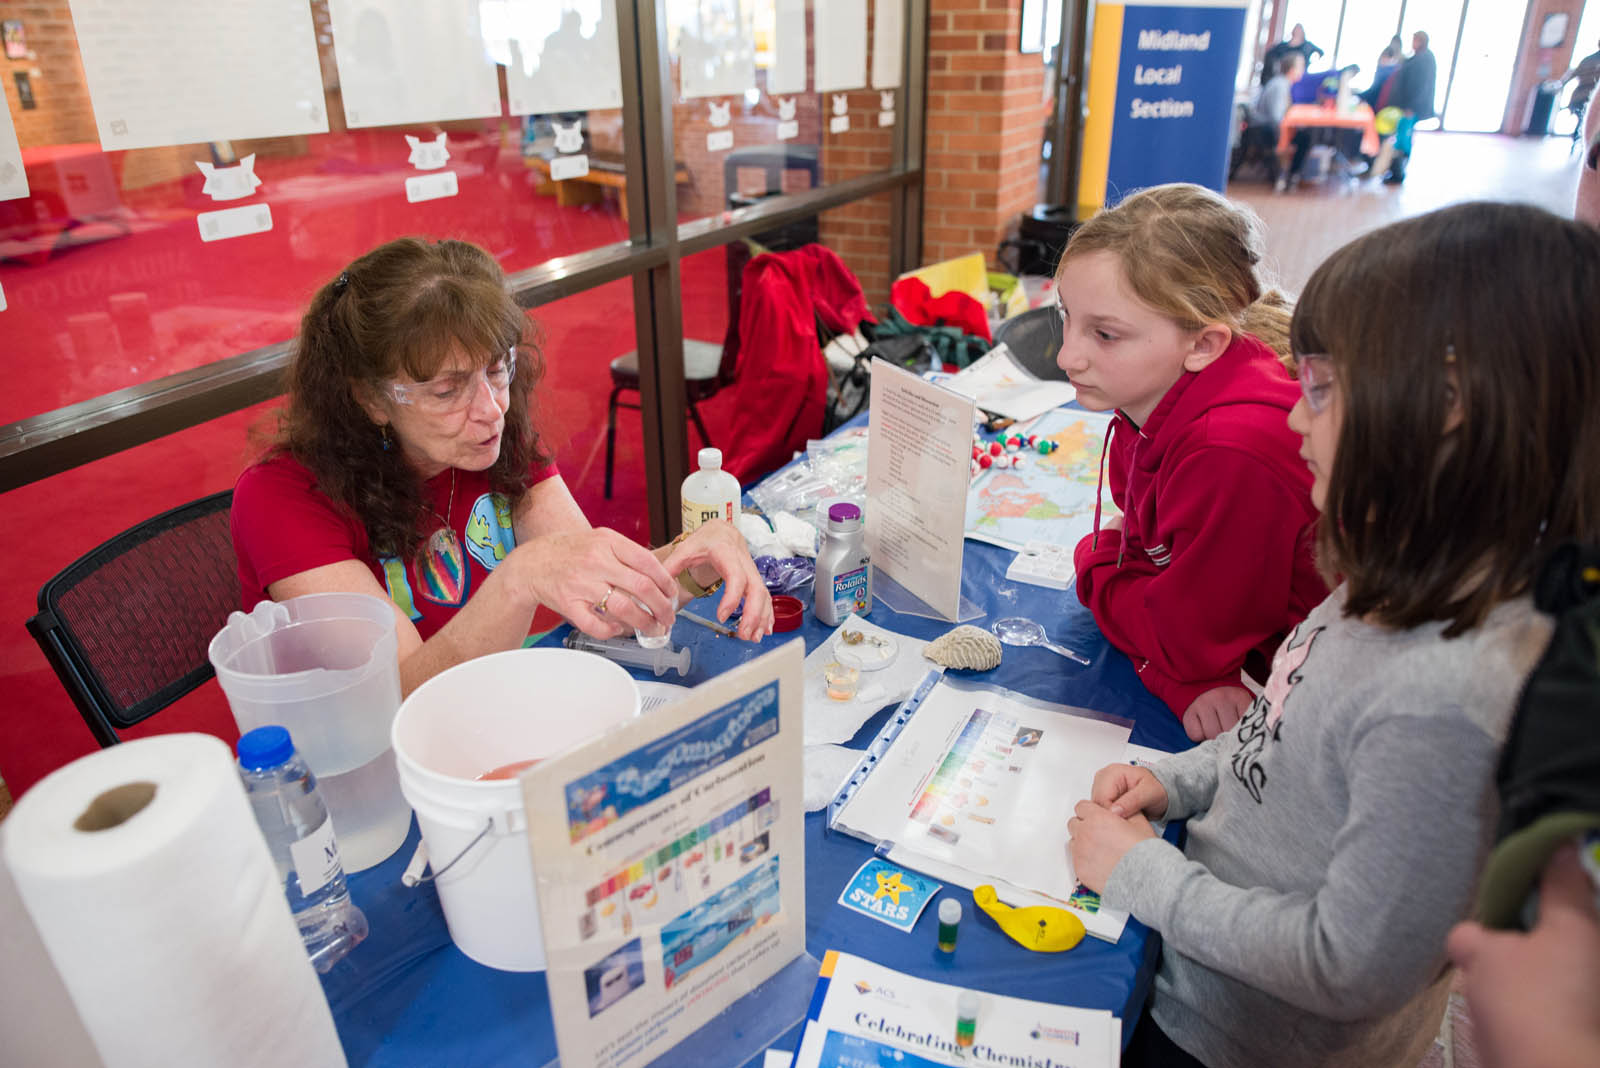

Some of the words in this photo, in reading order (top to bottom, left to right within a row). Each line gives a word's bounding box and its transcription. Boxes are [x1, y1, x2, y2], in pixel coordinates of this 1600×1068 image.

[1137, 29, 1211, 51] Midland
[1134, 64, 1183, 85] Local
[1130, 98, 1194, 119] Section
[835, 575, 867, 592] Rolaids
[849, 888, 909, 920] STARS
[875, 985, 896, 999] ACS
[855, 1012, 966, 1060] Celebrating
[972, 1045, 1075, 1068] Chemist
